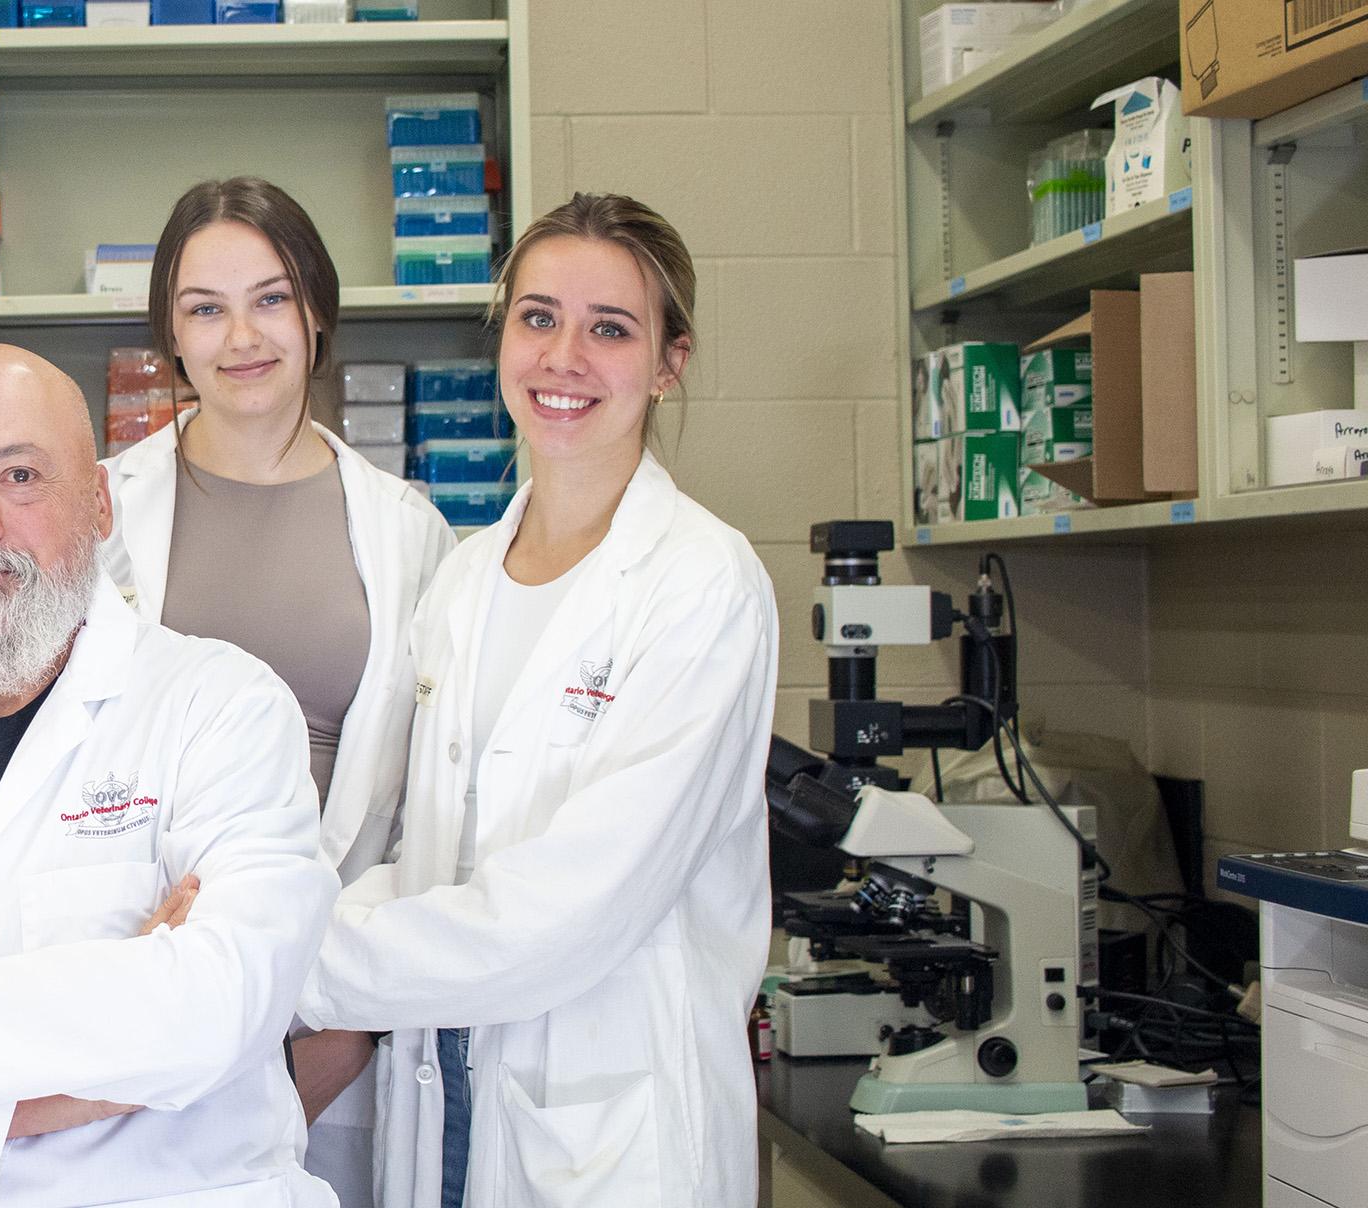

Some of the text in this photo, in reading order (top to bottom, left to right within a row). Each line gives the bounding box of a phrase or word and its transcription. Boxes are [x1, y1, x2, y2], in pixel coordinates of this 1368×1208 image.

[95, 789, 128, 805] OVC
[60, 796, 158, 822] Ontario Veterinary College
